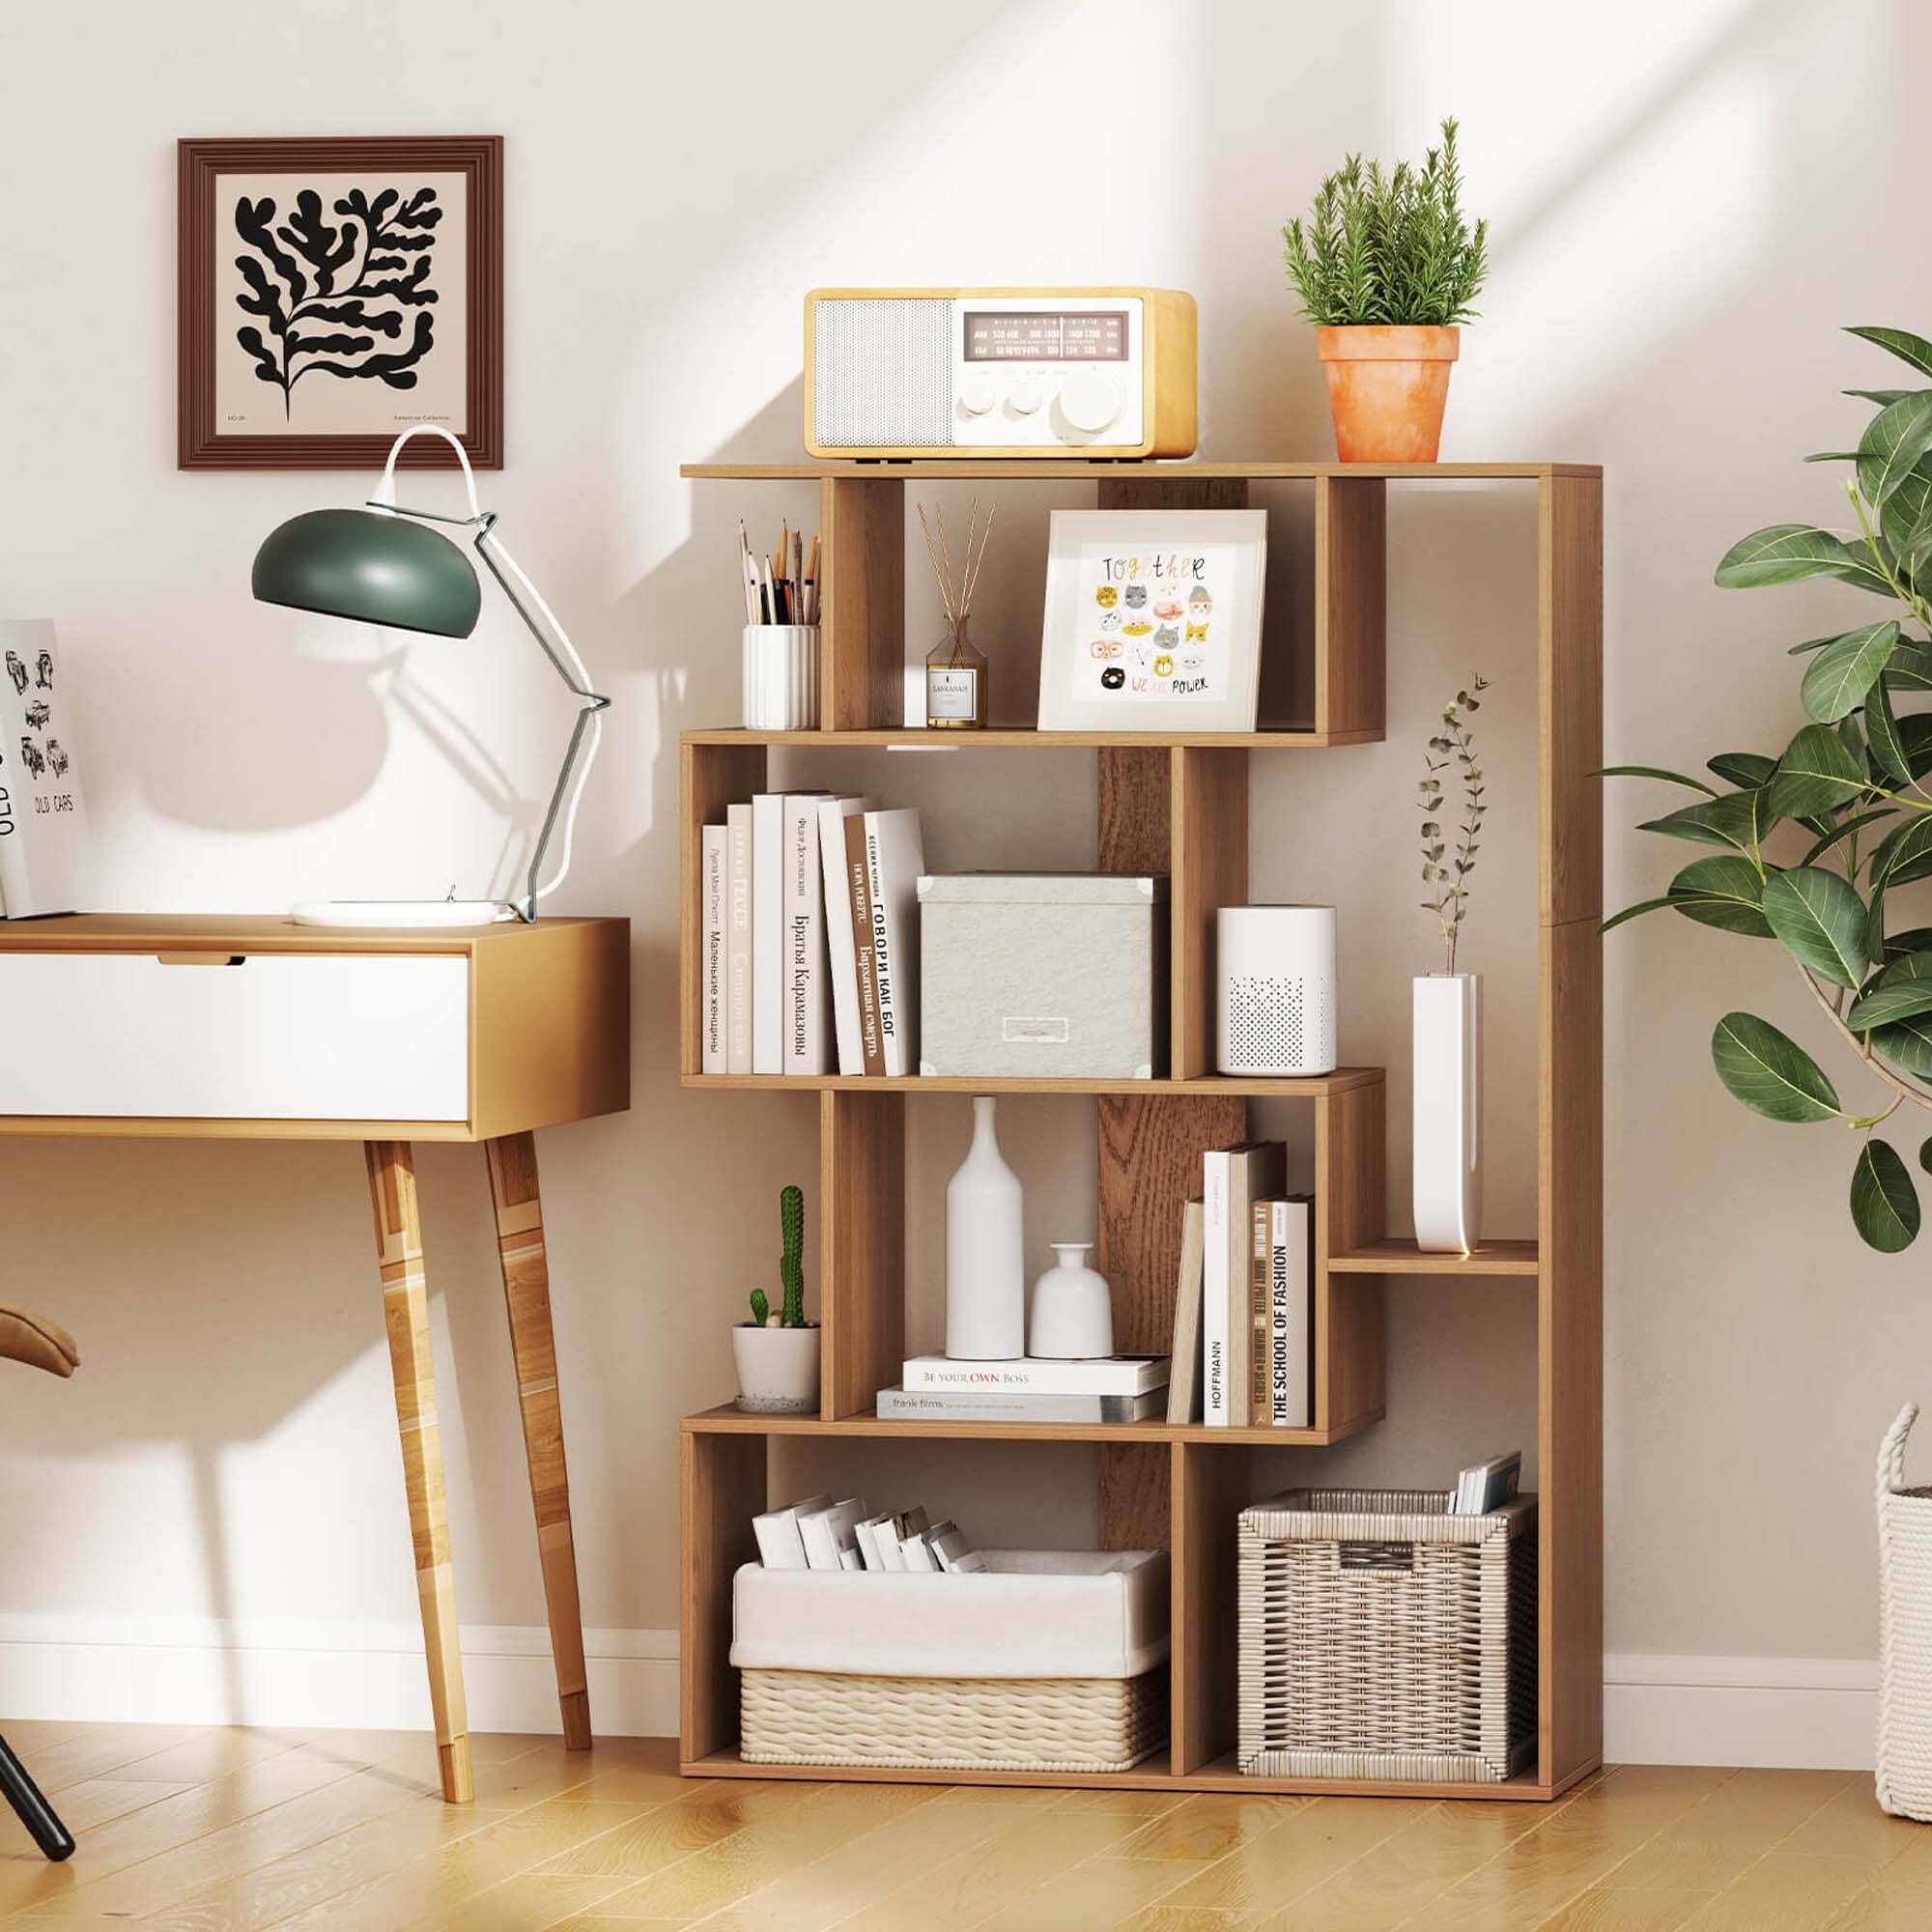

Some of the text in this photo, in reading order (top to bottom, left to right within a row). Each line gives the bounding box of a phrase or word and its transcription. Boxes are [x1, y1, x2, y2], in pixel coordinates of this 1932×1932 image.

[35, 794, 73, 813] OLD CARS
[710, 930, 721, 995] Маленькие
[791, 915, 810, 964] Братья
[873, 904, 888, 972] ГОВОРИ
[858, 946, 873, 1012] Бархатная
[879, 979, 891, 1005] КАК
[709, 997, 719, 1054] женщины
[792, 969, 810, 1056] Карамазовы
[865, 1014, 877, 1057] смерть
[882, 1011, 894, 1037] БОГ
[1273, 1245, 1287, 1421] THE SCHOOL OF FASHION
[969, 1373, 1001, 1383] OWN
[1211, 1341, 1221, 1409] HOFFMANN
[893, 1398, 917, 1407] frank
[920, 1398, 944, 1408] films
